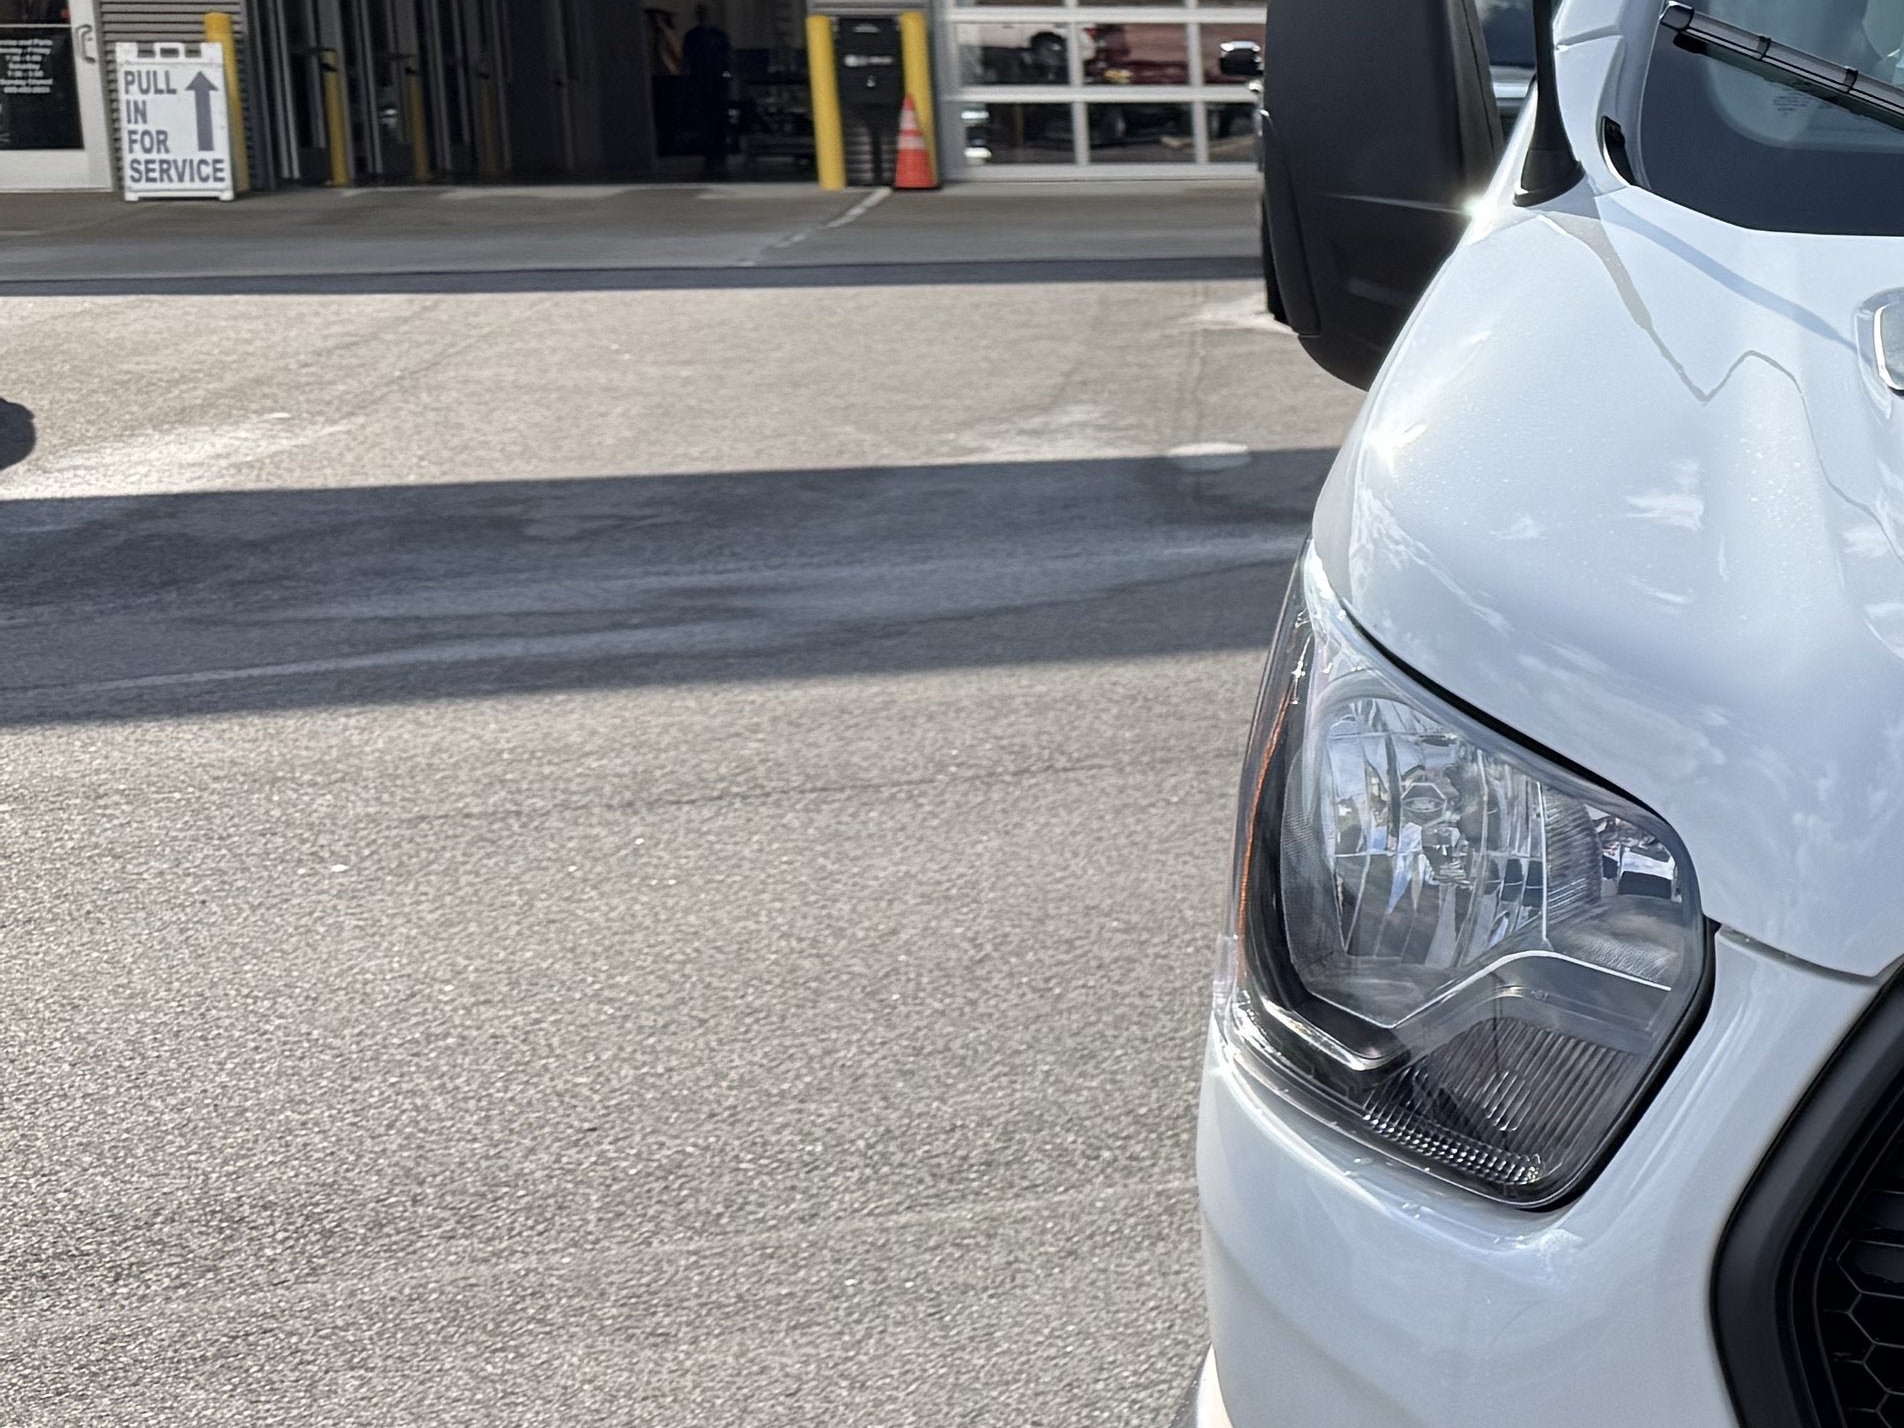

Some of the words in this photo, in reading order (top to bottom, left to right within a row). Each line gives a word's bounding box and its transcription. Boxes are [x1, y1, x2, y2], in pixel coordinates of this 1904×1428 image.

[124, 70, 177, 95] PULL
[126, 99, 147, 124] IN
[128, 129, 170, 154] FOR
[129, 158, 226, 183] SERVICE
